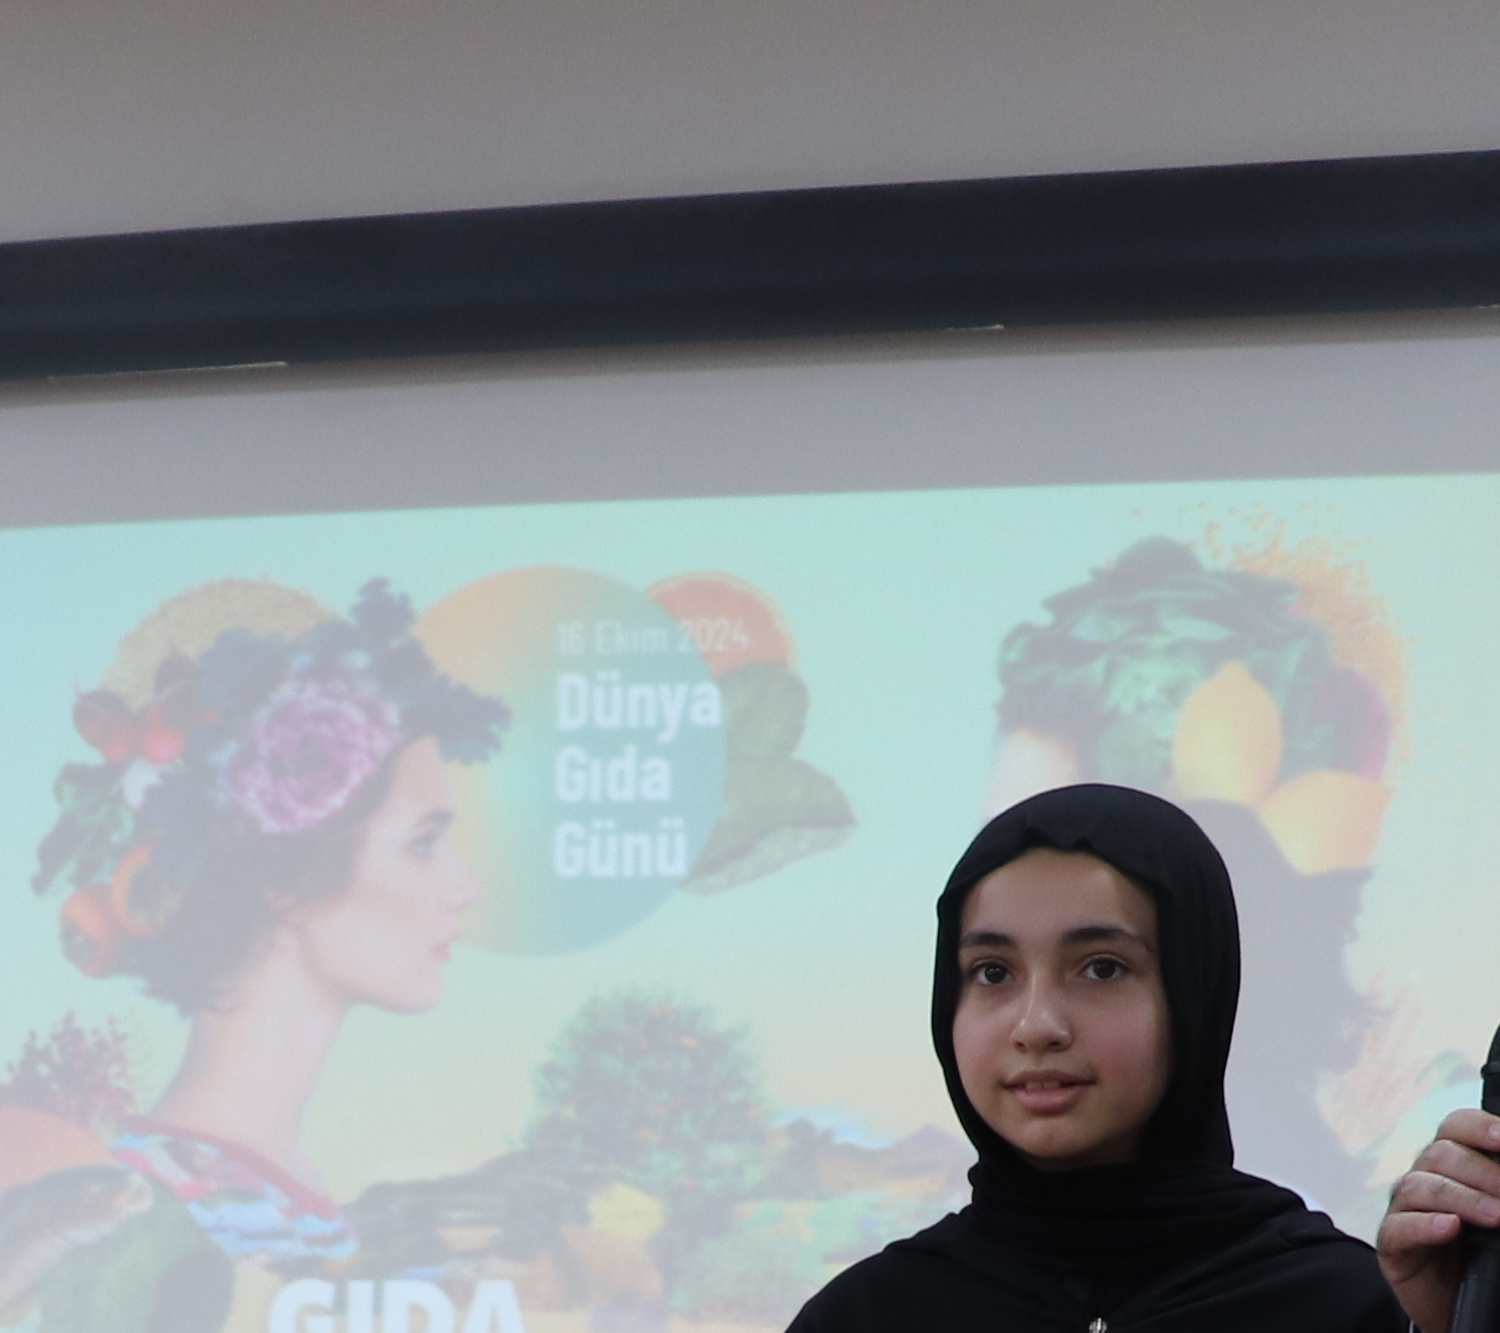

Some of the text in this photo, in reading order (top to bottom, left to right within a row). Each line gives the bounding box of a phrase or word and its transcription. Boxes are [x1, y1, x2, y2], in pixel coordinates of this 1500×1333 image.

[678, 617, 750, 654] 2024
[556, 669, 722, 743] Dünya
[554, 744, 672, 803] Gıda
[553, 817, 688, 879] Günü
